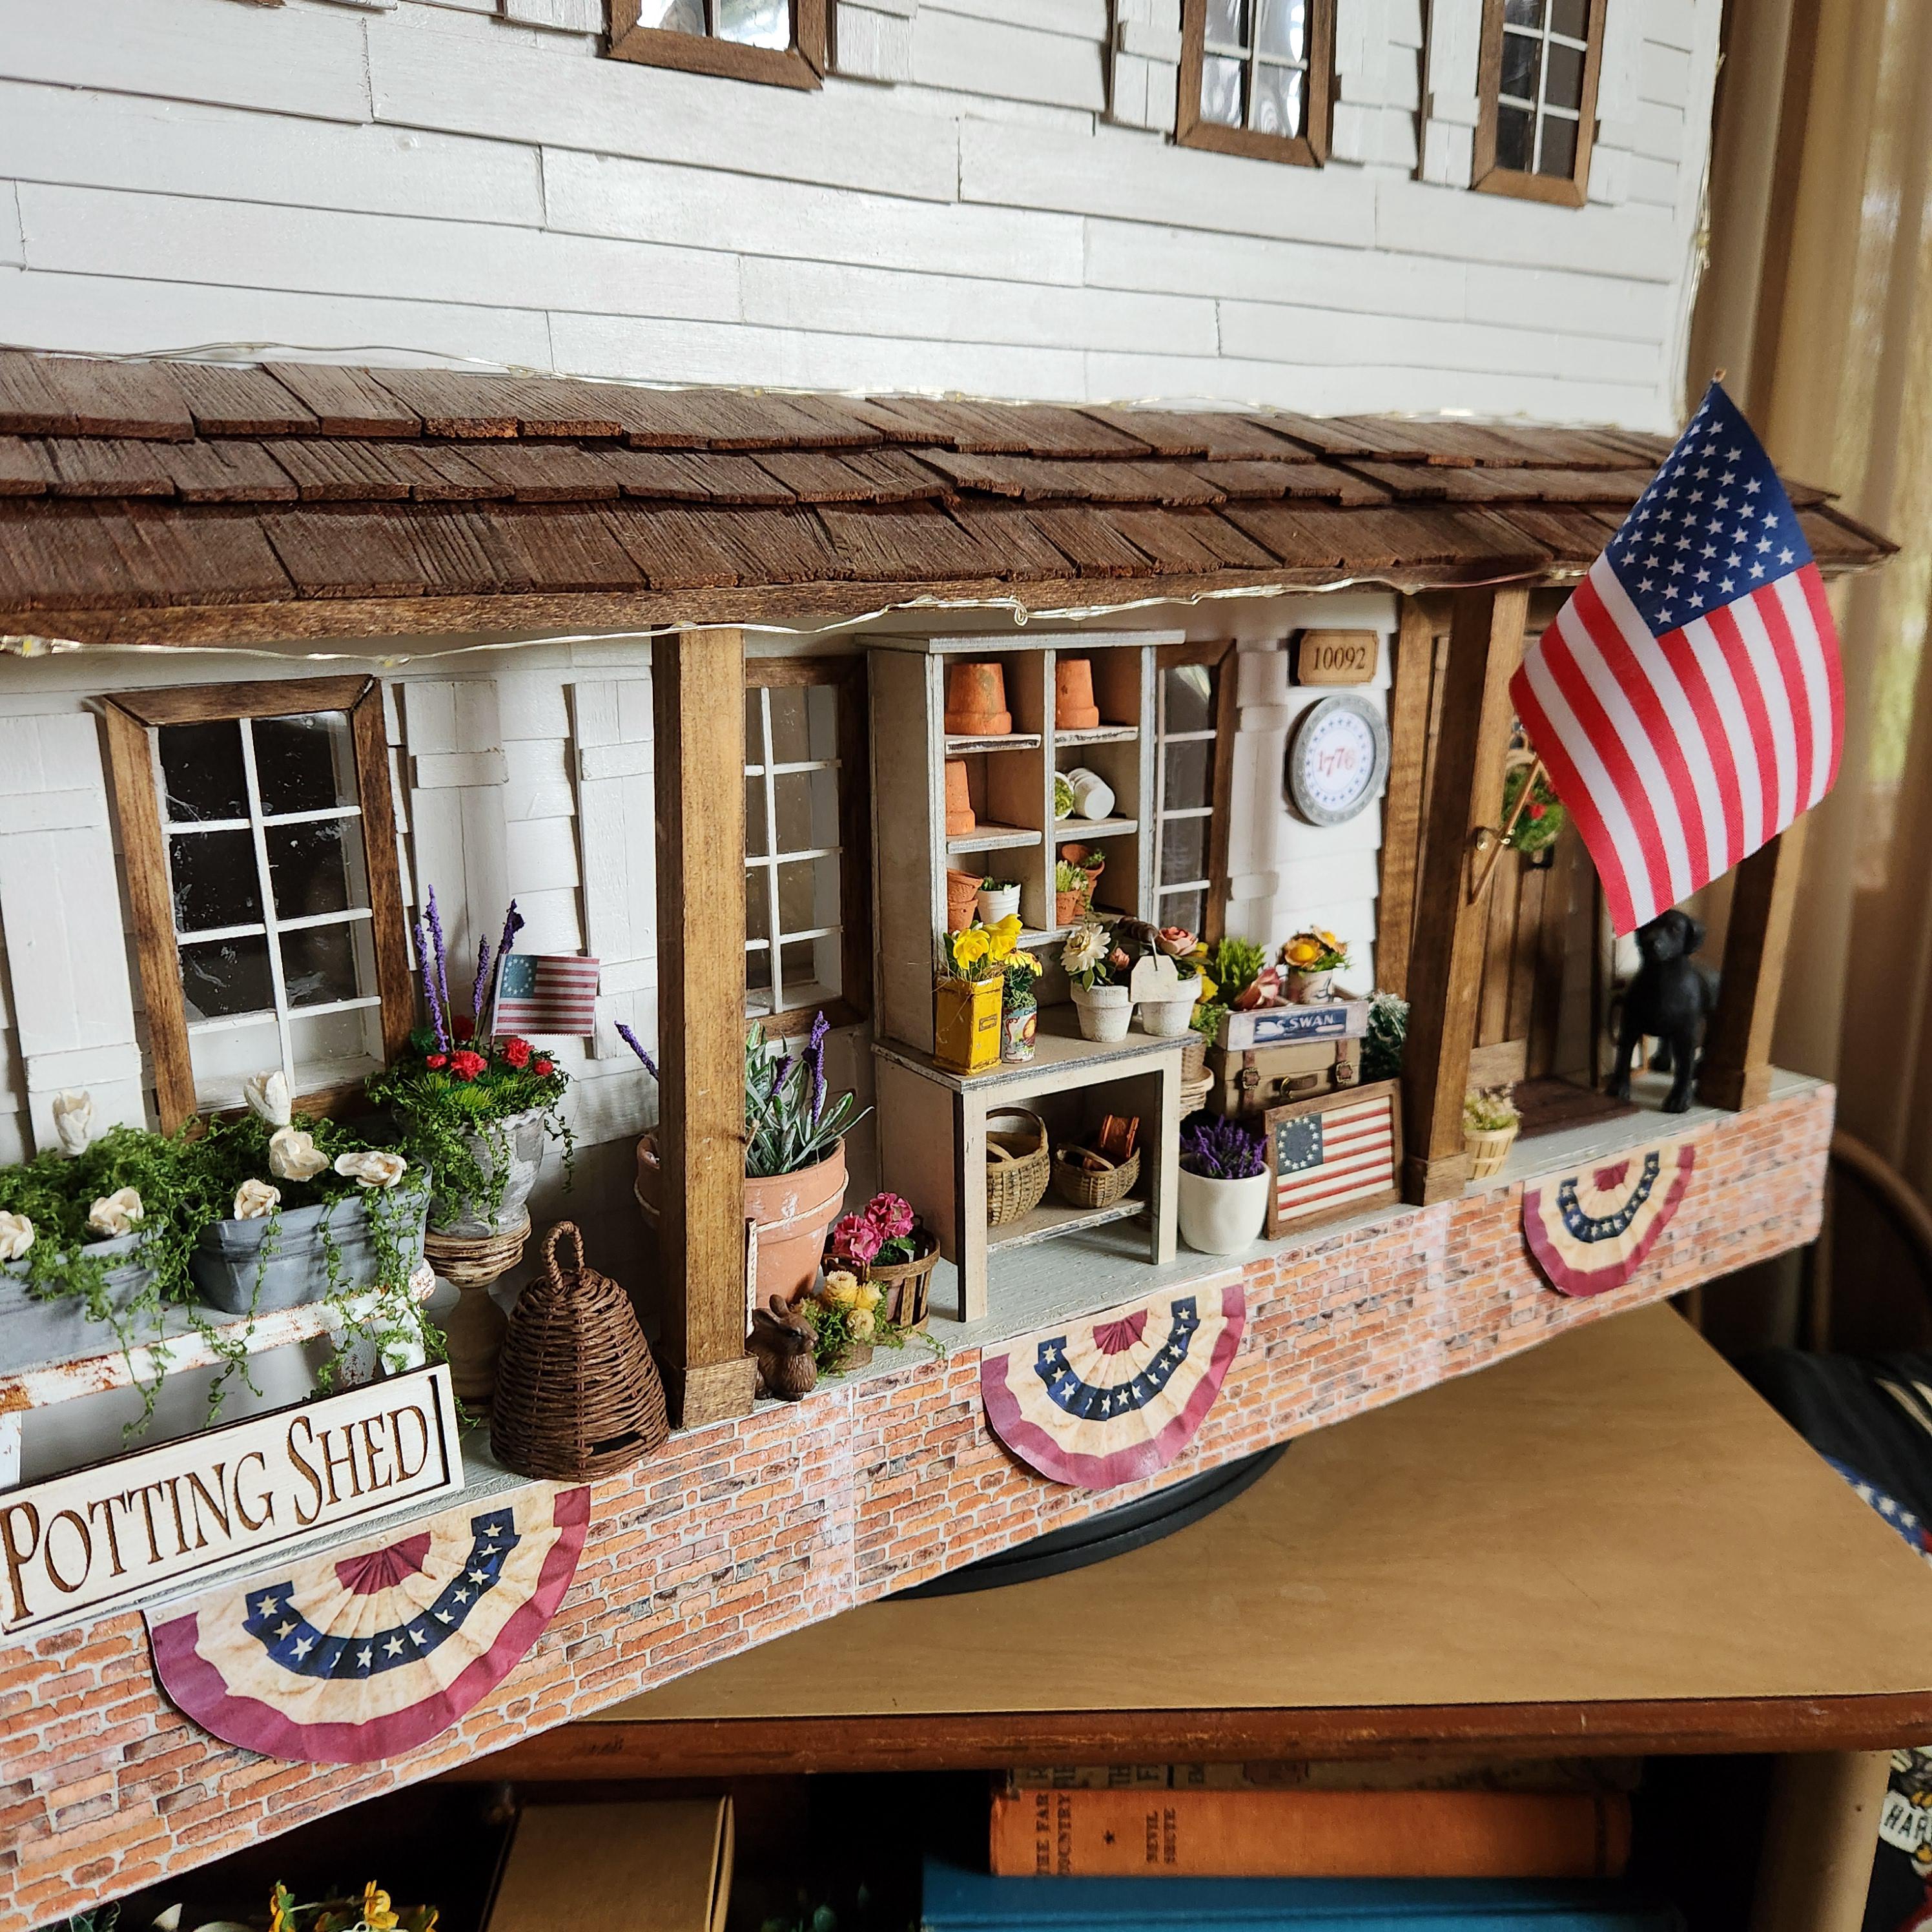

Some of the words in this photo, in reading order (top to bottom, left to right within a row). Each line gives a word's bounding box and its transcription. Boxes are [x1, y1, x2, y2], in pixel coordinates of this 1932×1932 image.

[1313, 646, 1366, 671] 10092
[1290, 1014, 1334, 1030] SWAN
[1, 1452, 276, 1623] POTTING
[287, 1404, 429, 1526] SHED
[1884, 1804, 1932, 1844] HAR
